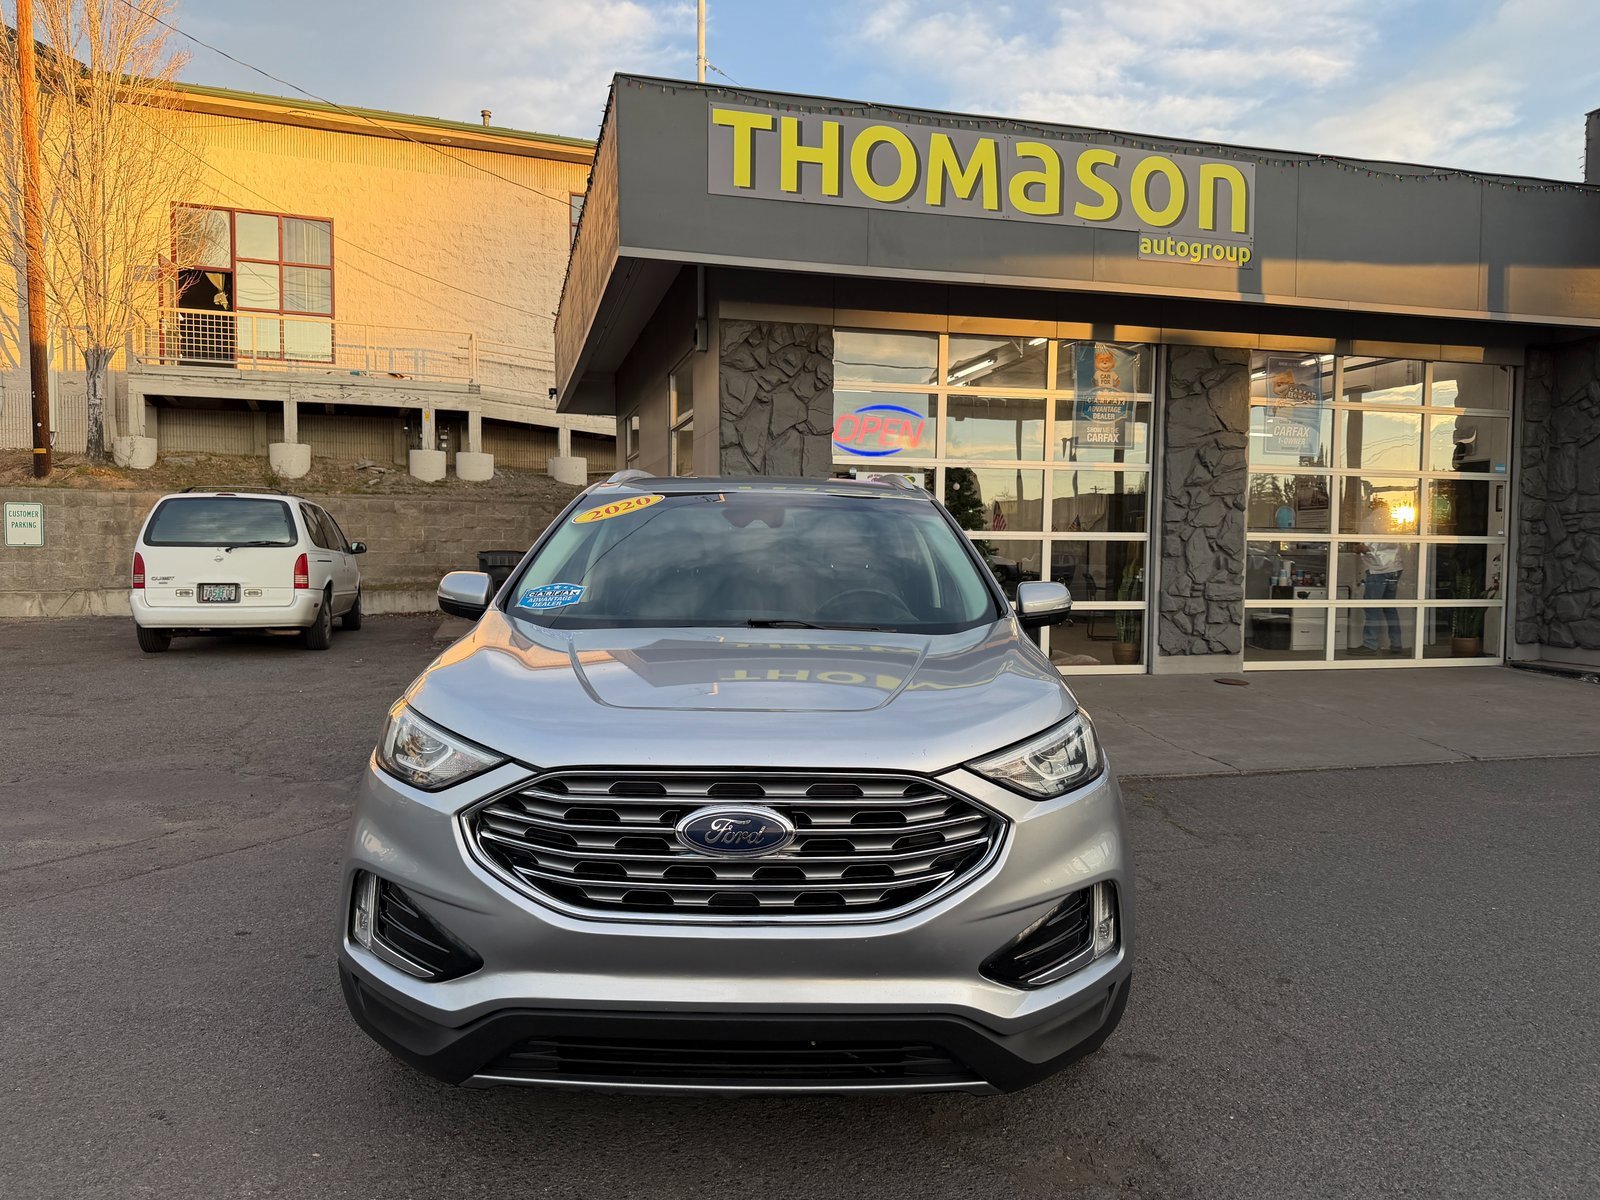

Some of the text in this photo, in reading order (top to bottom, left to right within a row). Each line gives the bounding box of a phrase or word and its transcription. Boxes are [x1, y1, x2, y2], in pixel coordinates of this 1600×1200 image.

[1140, 236, 1251, 266] autogroup
[1087, 405, 1122, 413] ADVANTAGE
[1092, 412, 1116, 420] DEALER
[833, 413, 925, 449] OPEN
[1273, 425, 1310, 438] CARFAX
[1086, 433, 1120, 443] CARFAX
[8, 510, 39, 518] CUSTOMER
[588, 497, 651, 521] 2020
[11, 521, 37, 529] PARKING
[704, 818, 765, 844] Ford
